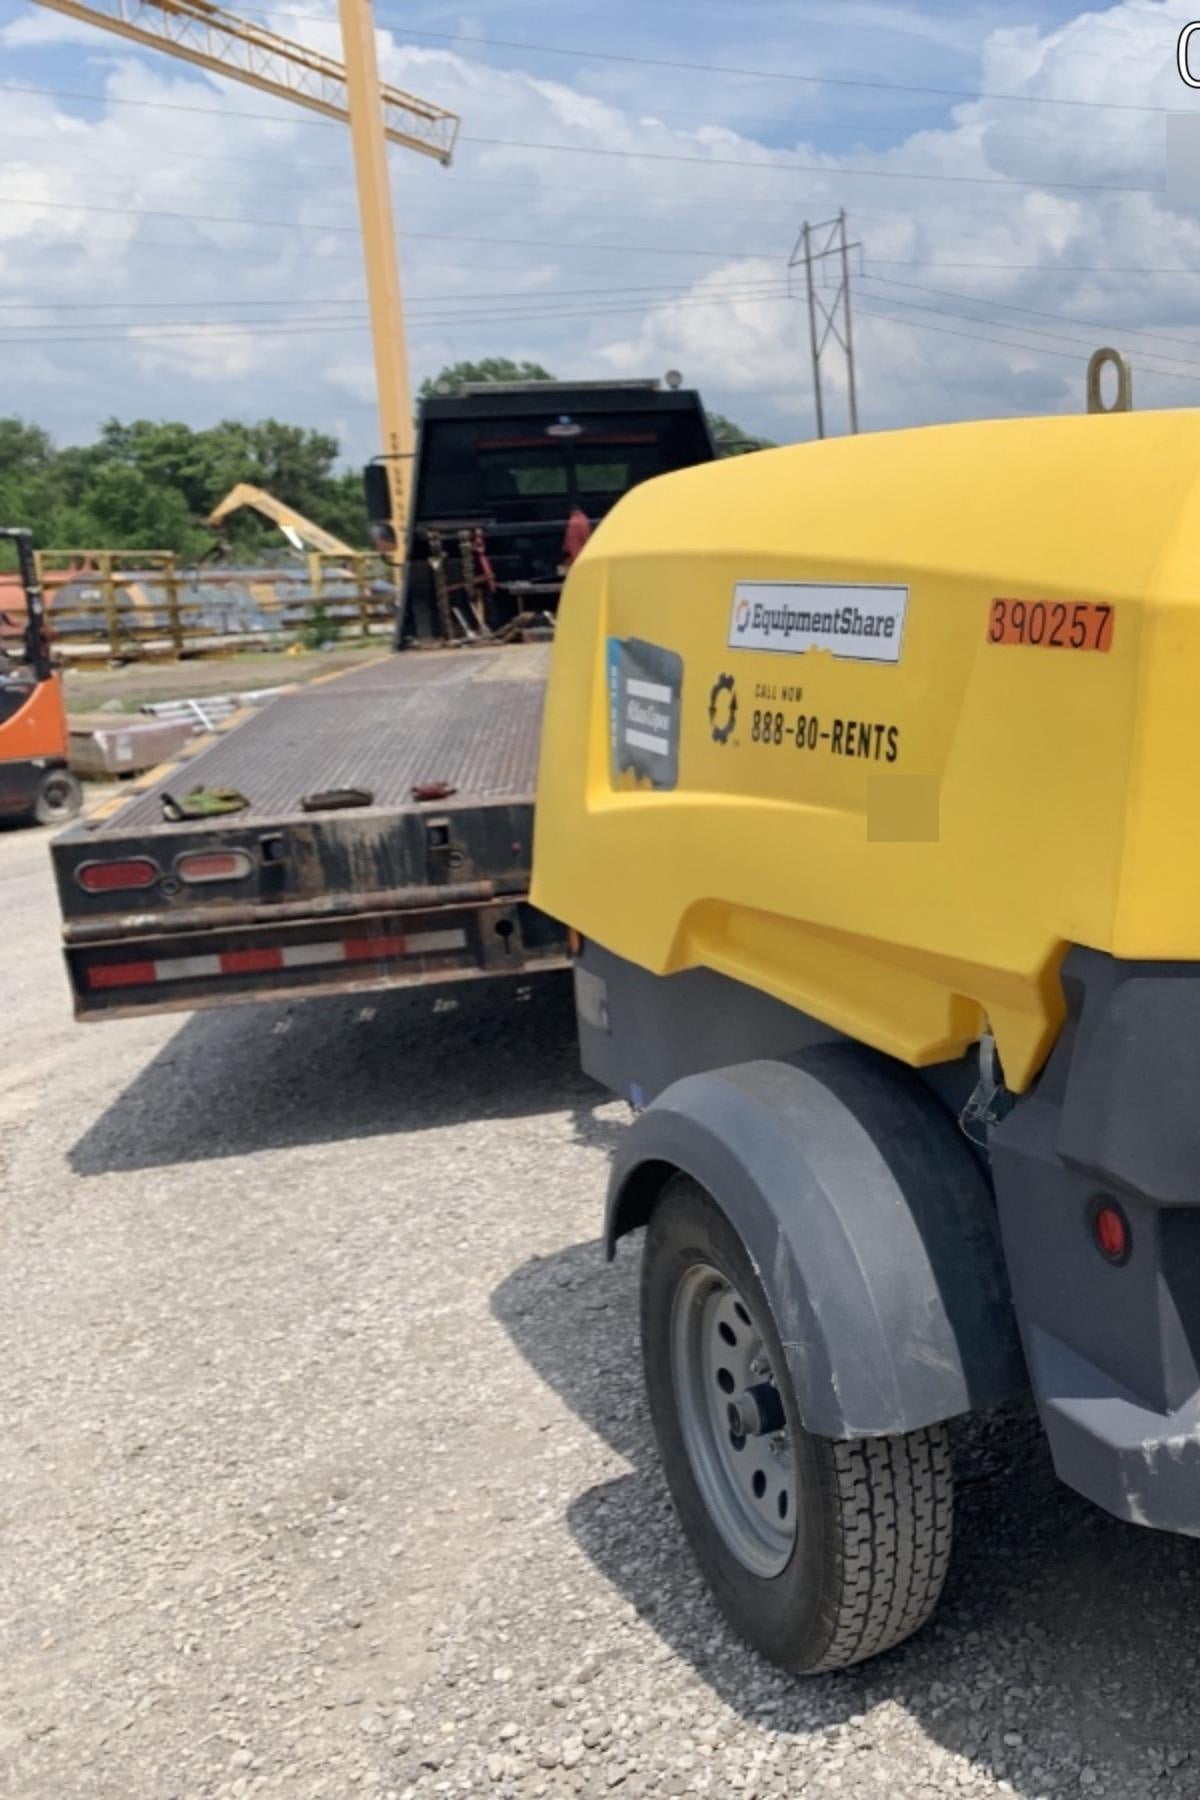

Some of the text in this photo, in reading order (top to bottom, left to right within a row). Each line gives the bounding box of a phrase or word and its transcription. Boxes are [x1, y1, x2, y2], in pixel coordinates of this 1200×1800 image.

[752, 602, 896, 638] EquipmentShare
[990, 600, 1111, 649] 390257
[754, 683, 804, 703] CALL NOW
[752, 709, 899, 763] 888-80-RENTS
